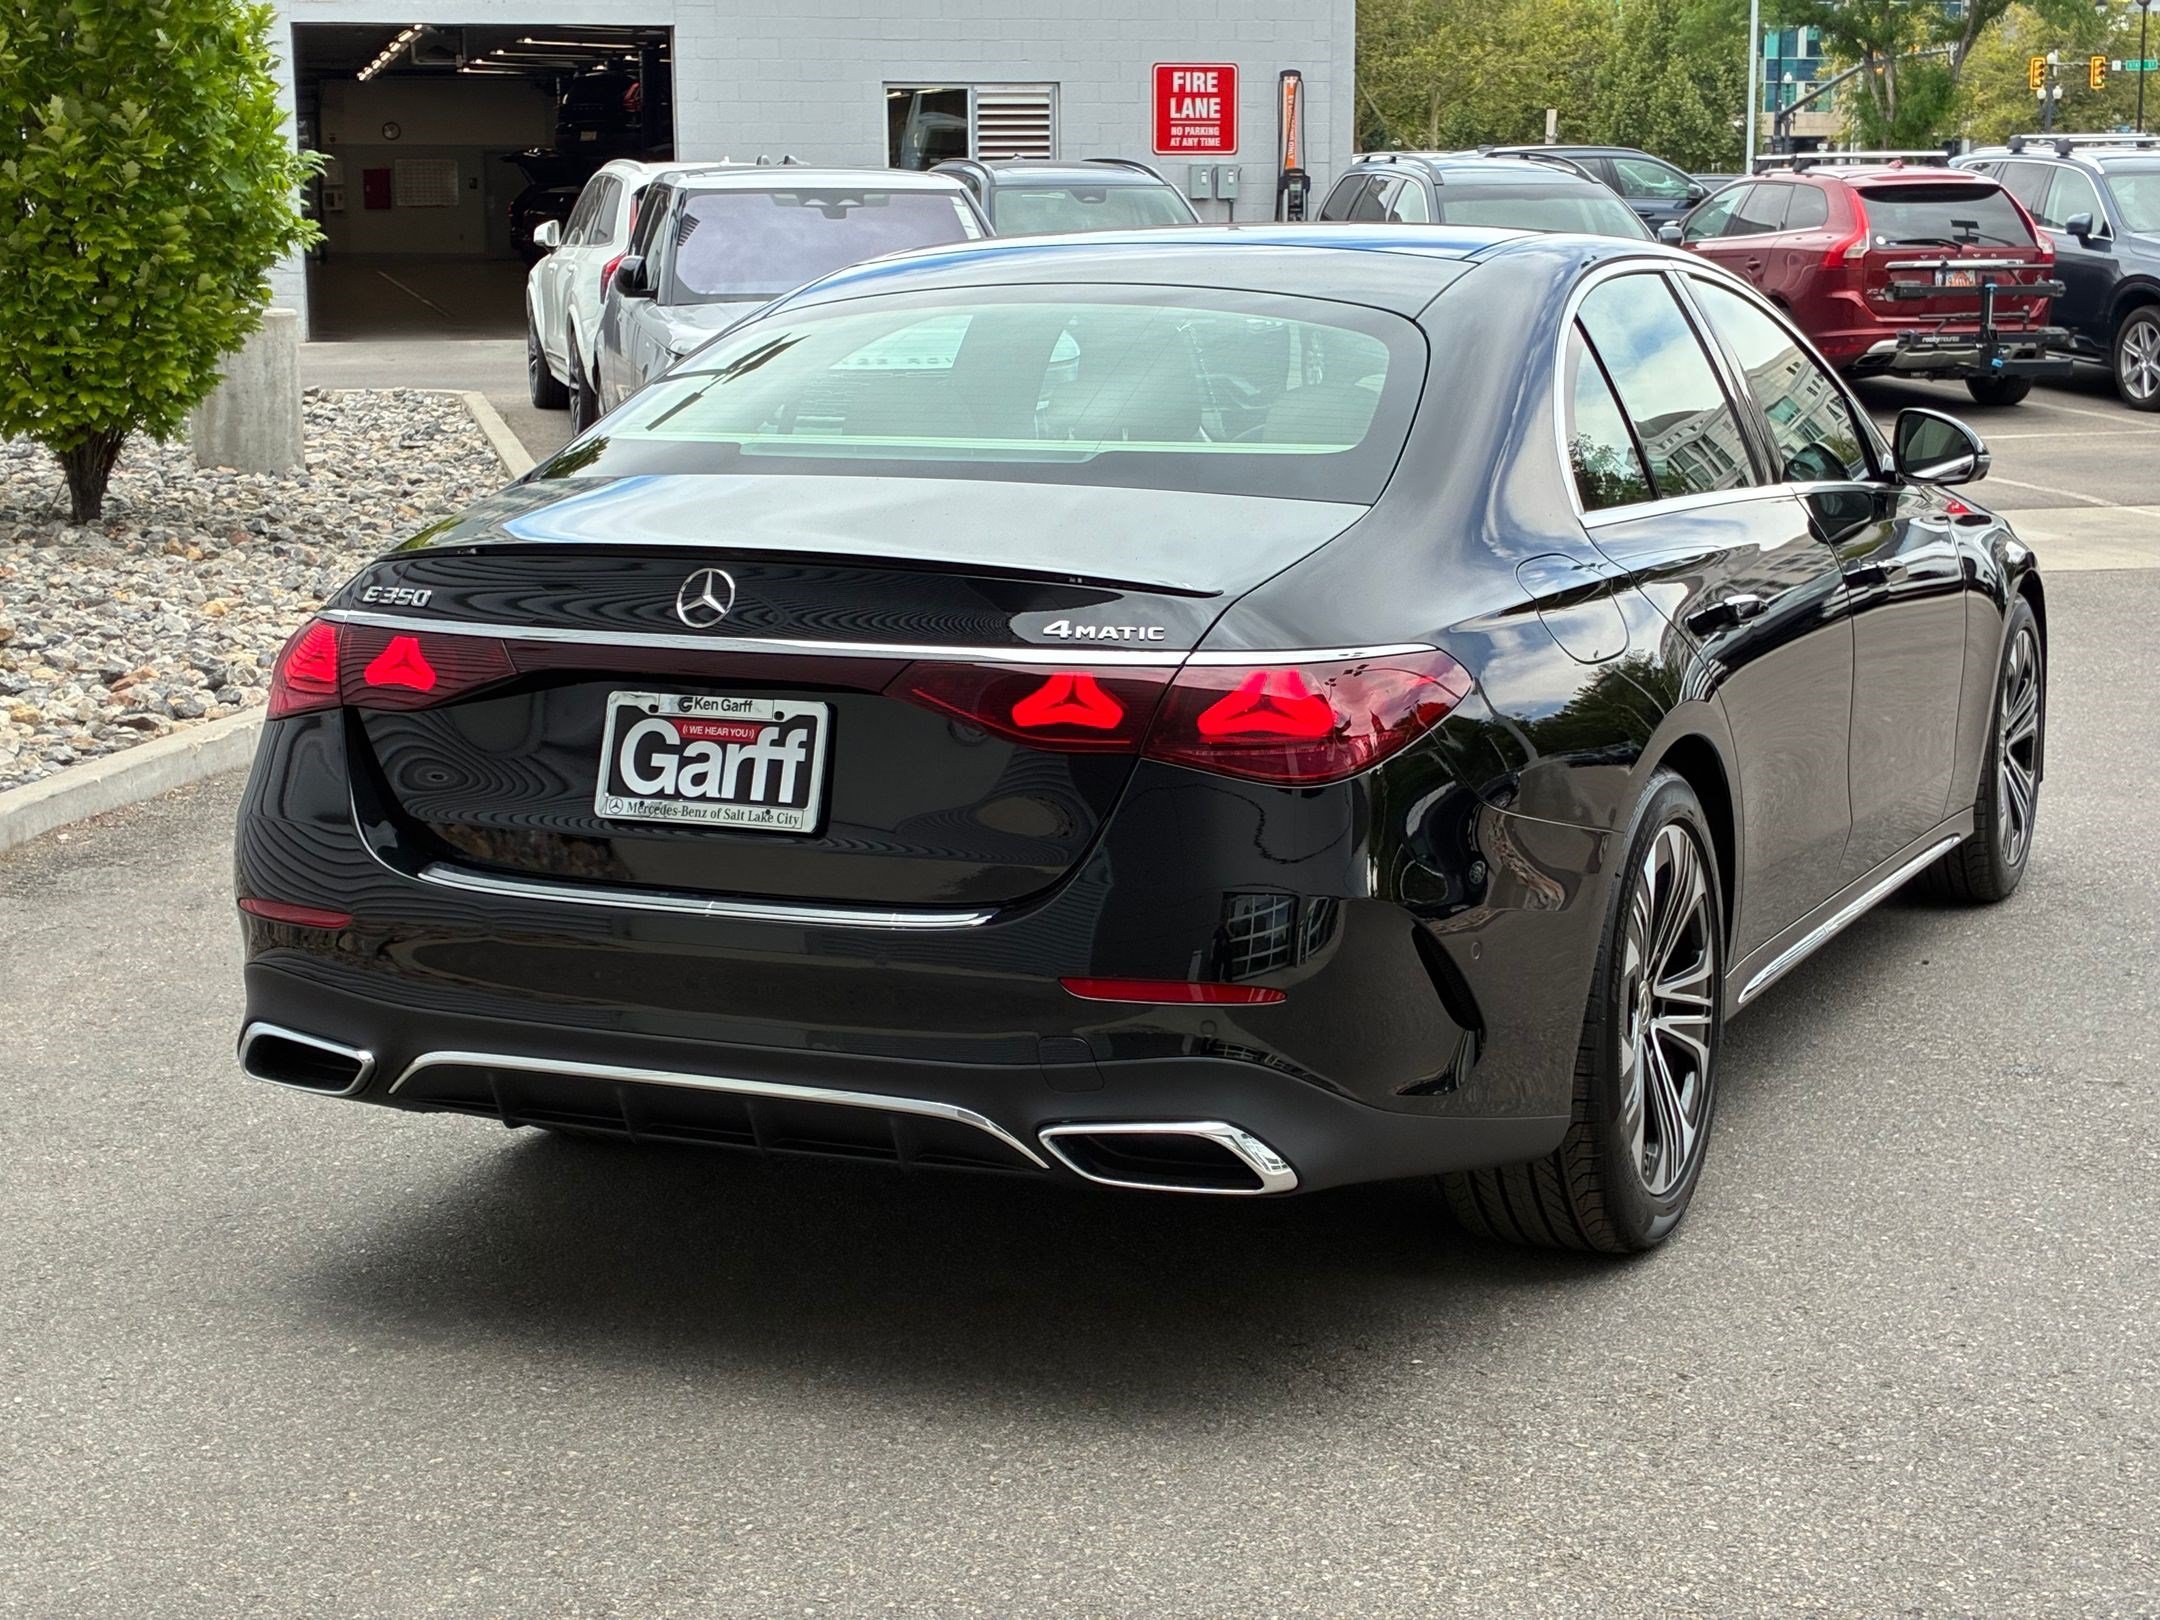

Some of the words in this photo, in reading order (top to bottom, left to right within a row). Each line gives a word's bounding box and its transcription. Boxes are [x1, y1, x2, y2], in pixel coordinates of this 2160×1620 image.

[1172, 71, 1219, 93] FIRE
[1169, 97, 1221, 119] LANE
[1169, 137, 1181, 147] AT
[1182, 137, 1199, 147] ANY
[1200, 137, 1221, 147] TIME
[1170, 126, 1183, 136] NO
[1184, 126, 1220, 136] PARKING
[1043, 619, 1165, 641] 4MATIC
[694, 696, 719, 711] Ken
[720, 698, 753, 713] Garff
[689, 724, 704, 735] WE
[704, 726, 729, 737] HEAR
[729, 728, 749, 739] YOU
[619, 717, 809, 804] Garff
[626, 801, 708, 819] Mercedes-Benz
[710, 808, 722, 819] of
[723, 809, 745, 822] Salt
[748, 811, 774, 823] Lake
[776, 812, 801, 828] City
